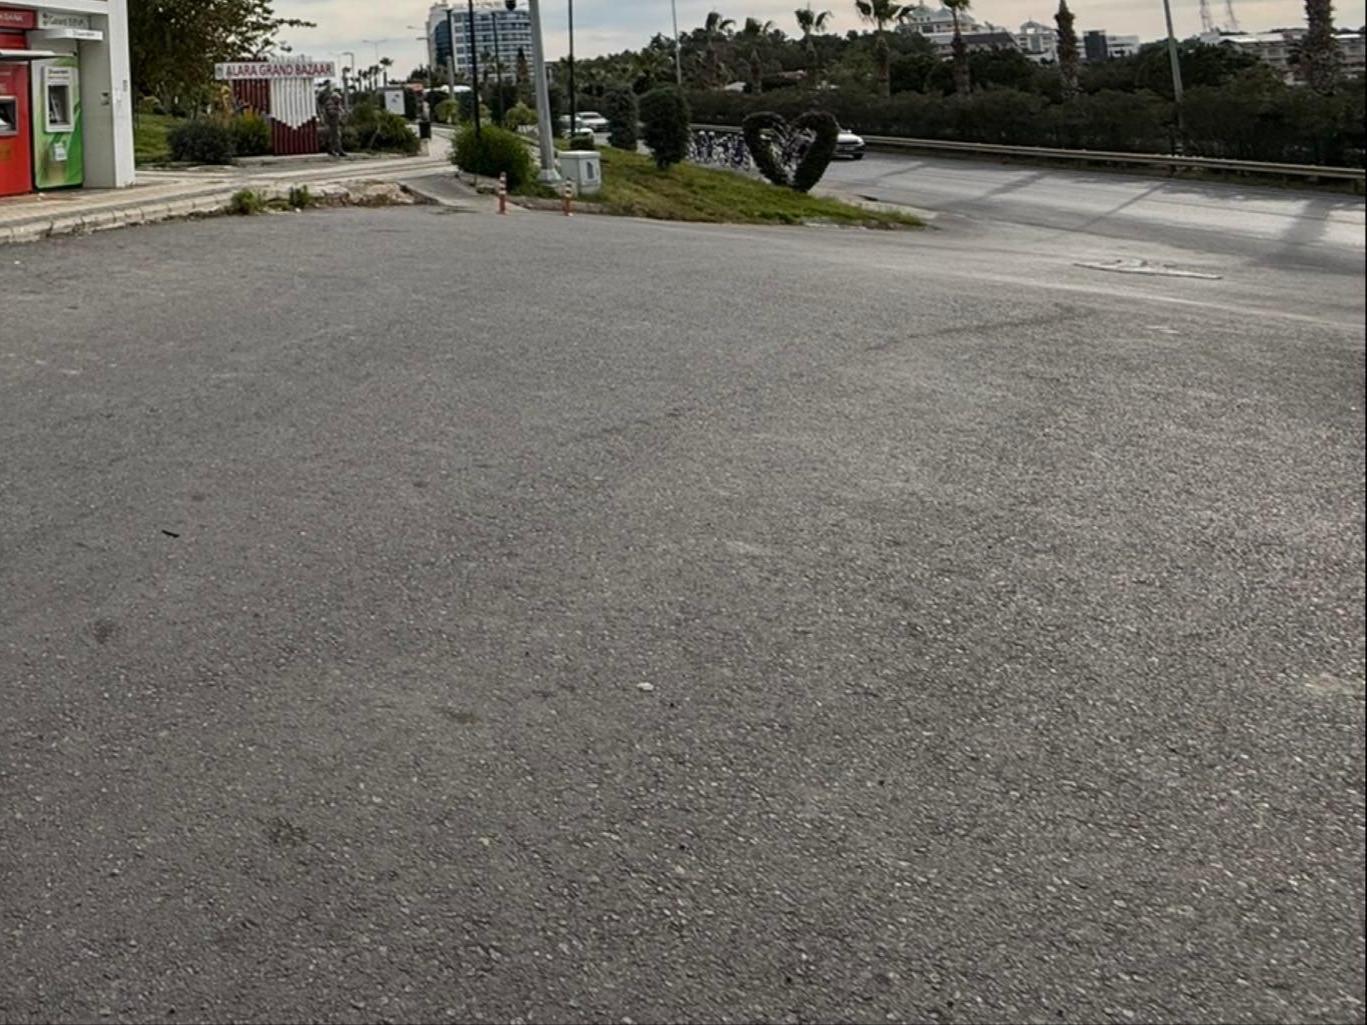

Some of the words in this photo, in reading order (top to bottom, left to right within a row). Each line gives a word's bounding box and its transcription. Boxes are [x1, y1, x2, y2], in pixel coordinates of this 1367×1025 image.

[225, 64, 258, 77] ALARA
[258, 63, 294, 76] GRAND
[295, 62, 332, 75] BAZAAR
